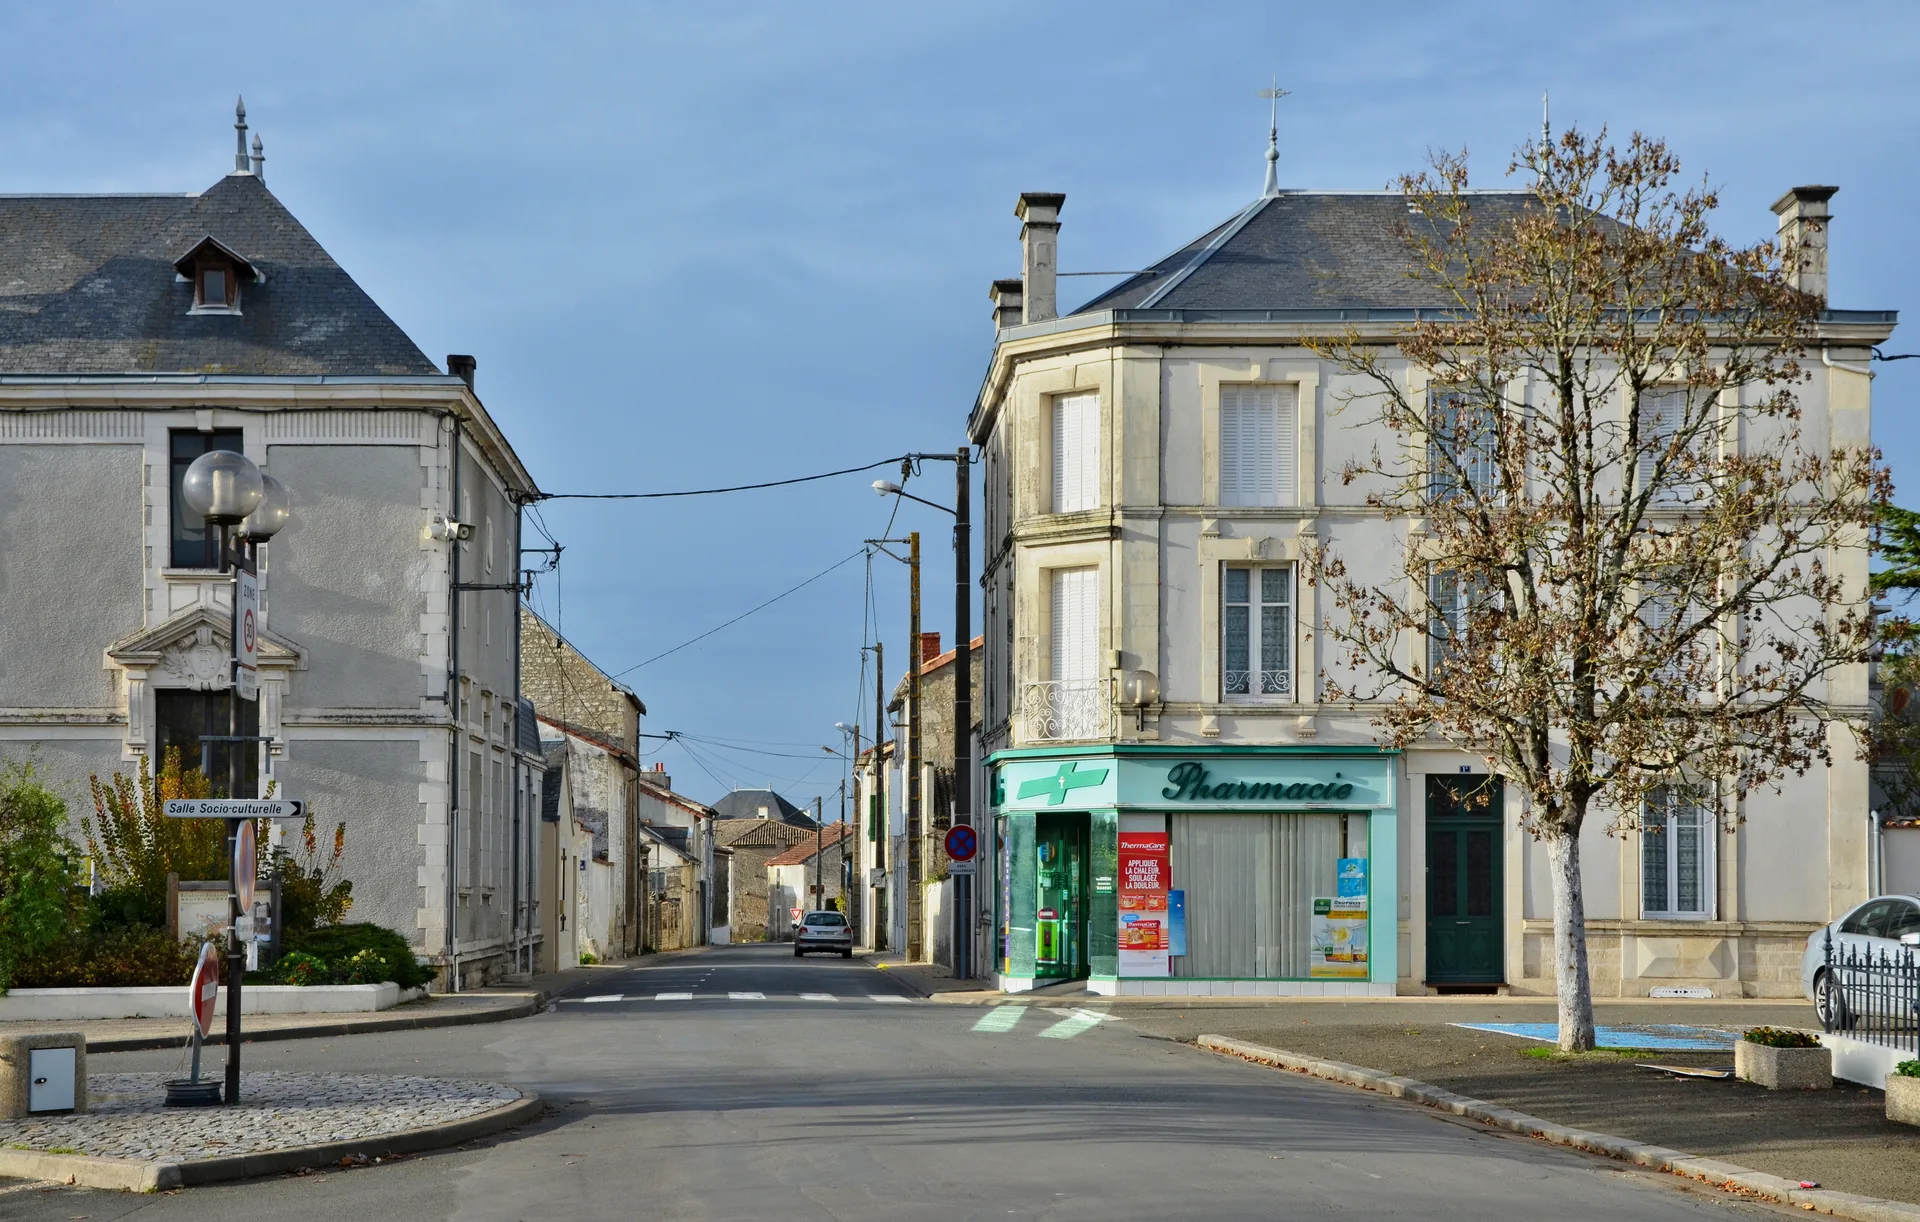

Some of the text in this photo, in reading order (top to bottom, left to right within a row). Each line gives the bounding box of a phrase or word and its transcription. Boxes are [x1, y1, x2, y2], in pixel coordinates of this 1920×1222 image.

[244, 584, 255, 601] ZONE
[1161, 761, 1353, 801] Pharmacie
[169, 803, 281, 814] Salle Socio-culturelle
